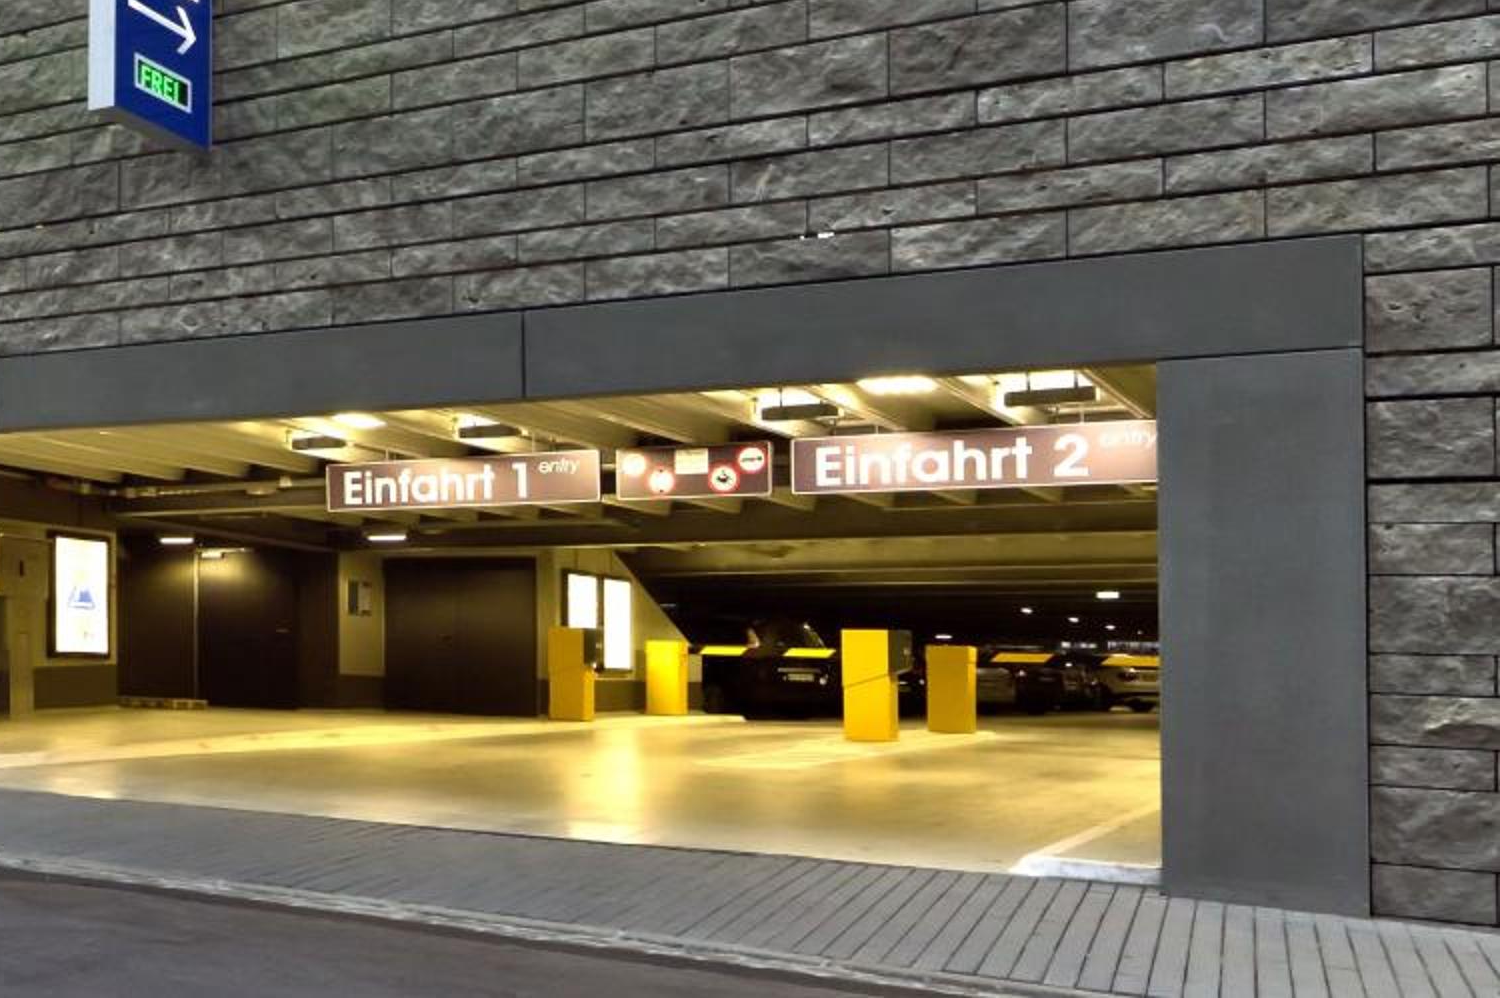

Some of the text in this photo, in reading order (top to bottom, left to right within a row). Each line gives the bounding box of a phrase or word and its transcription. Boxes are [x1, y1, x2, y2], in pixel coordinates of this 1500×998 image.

[141, 64, 179, 104] FREI
[343, 457, 580, 506] Einfahrt 1 entry
[815, 436, 1033, 486] Einfahrt
[1053, 433, 1090, 478] 2
